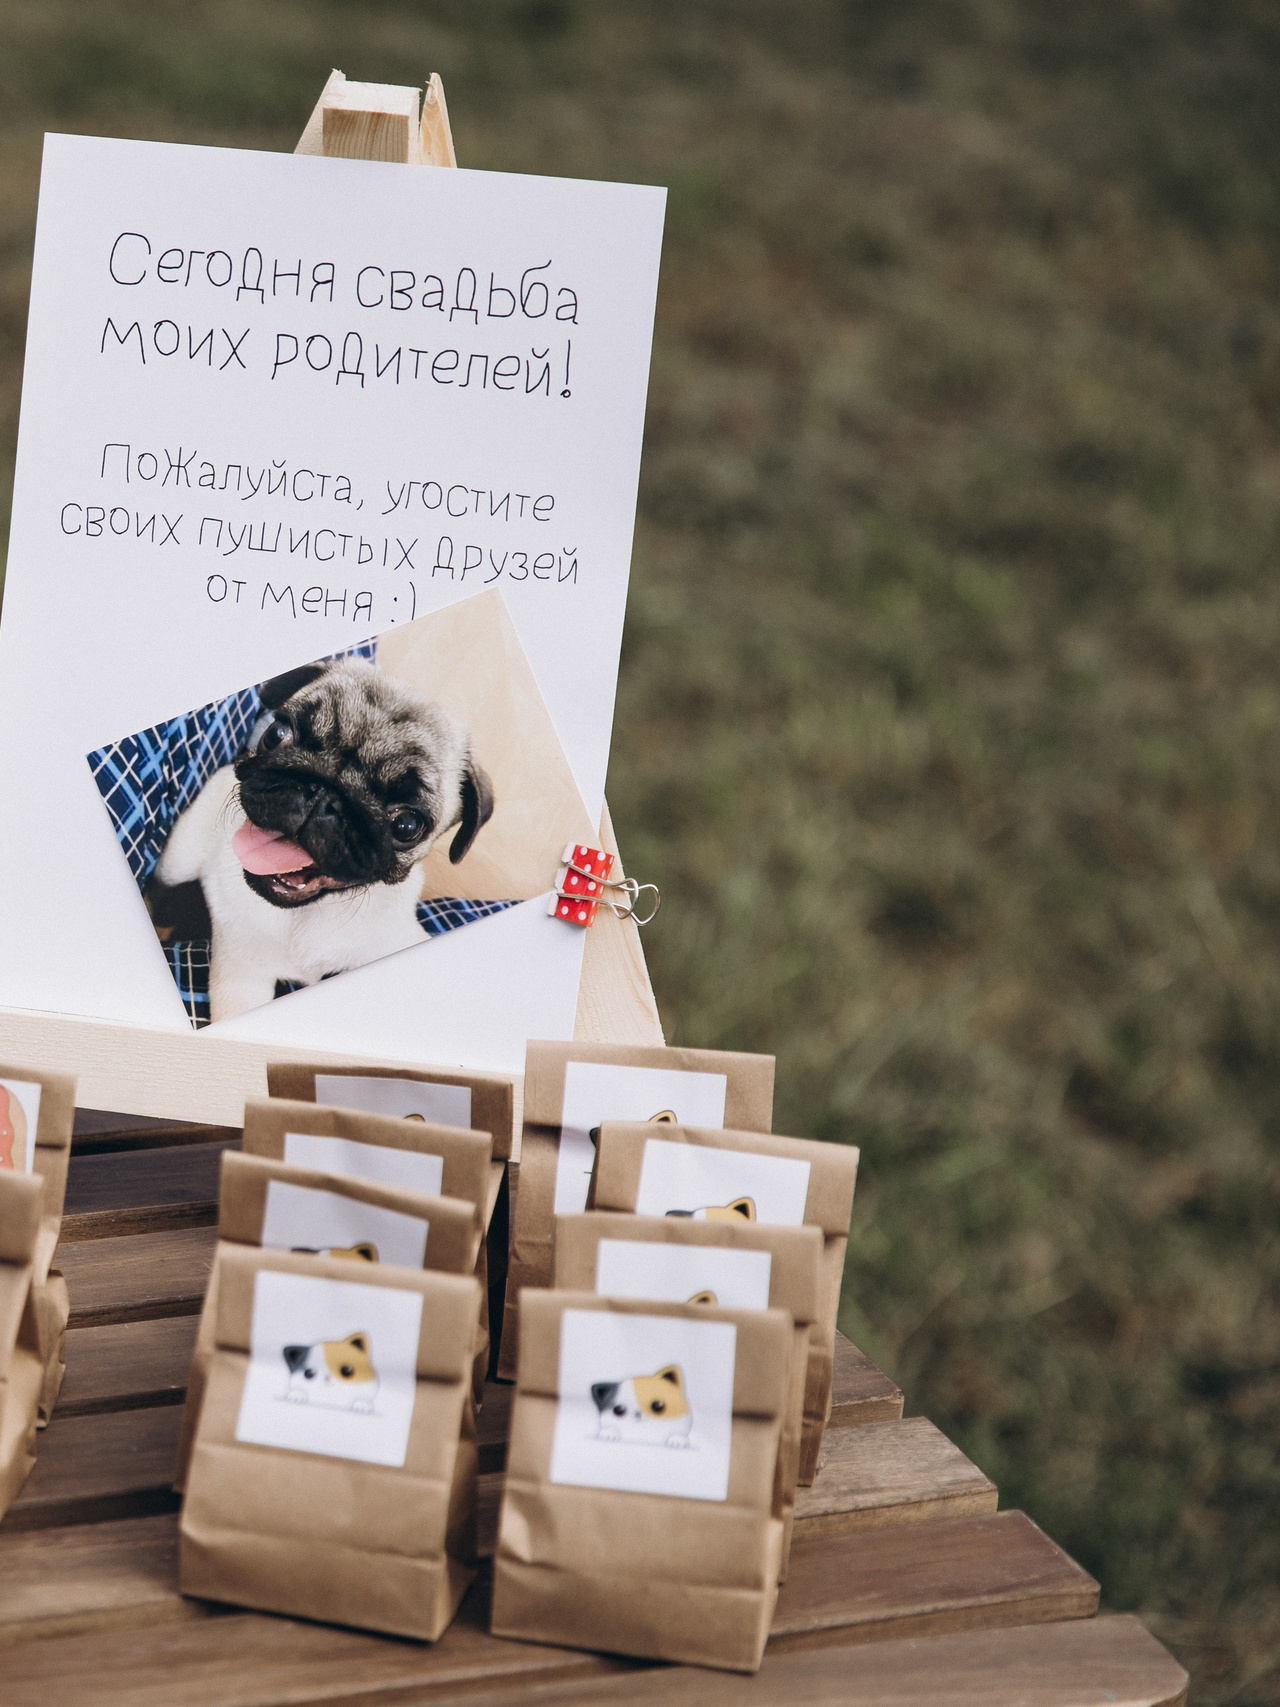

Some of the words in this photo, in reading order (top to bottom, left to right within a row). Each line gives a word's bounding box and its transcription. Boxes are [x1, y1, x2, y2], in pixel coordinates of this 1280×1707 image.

[109, 231, 336, 305] Сегодня
[356, 259, 579, 326] свадьба
[100, 316, 251, 371] моих
[270, 331, 572, 399] родителей!
[380, 480, 555, 522] угостите
[60, 502, 184, 547] своих
[198, 516, 419, 571] пушистых
[431, 535, 578, 585] друзей
[206, 574, 247, 604] от
[260, 581, 373, 623] меня
